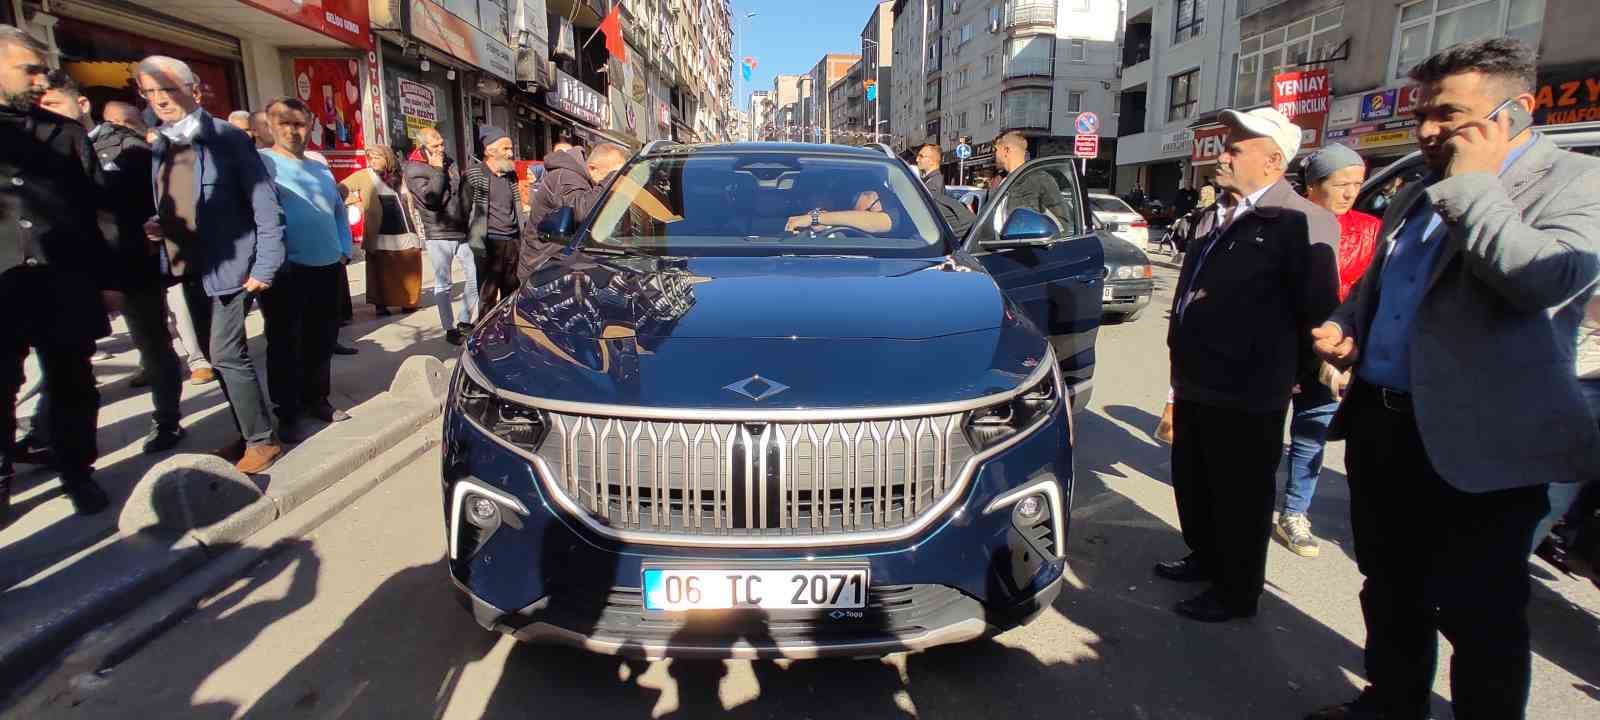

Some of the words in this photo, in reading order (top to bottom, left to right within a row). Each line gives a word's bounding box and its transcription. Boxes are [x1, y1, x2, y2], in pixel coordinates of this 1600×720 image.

[1277, 74, 1326, 96] YENİAY
[1278, 95, 1327, 116] PEYNİRCİLİK
[665, 575, 702, 604] 06
[726, 575, 763, 604] TC
[790, 574, 863, 605] 2071
